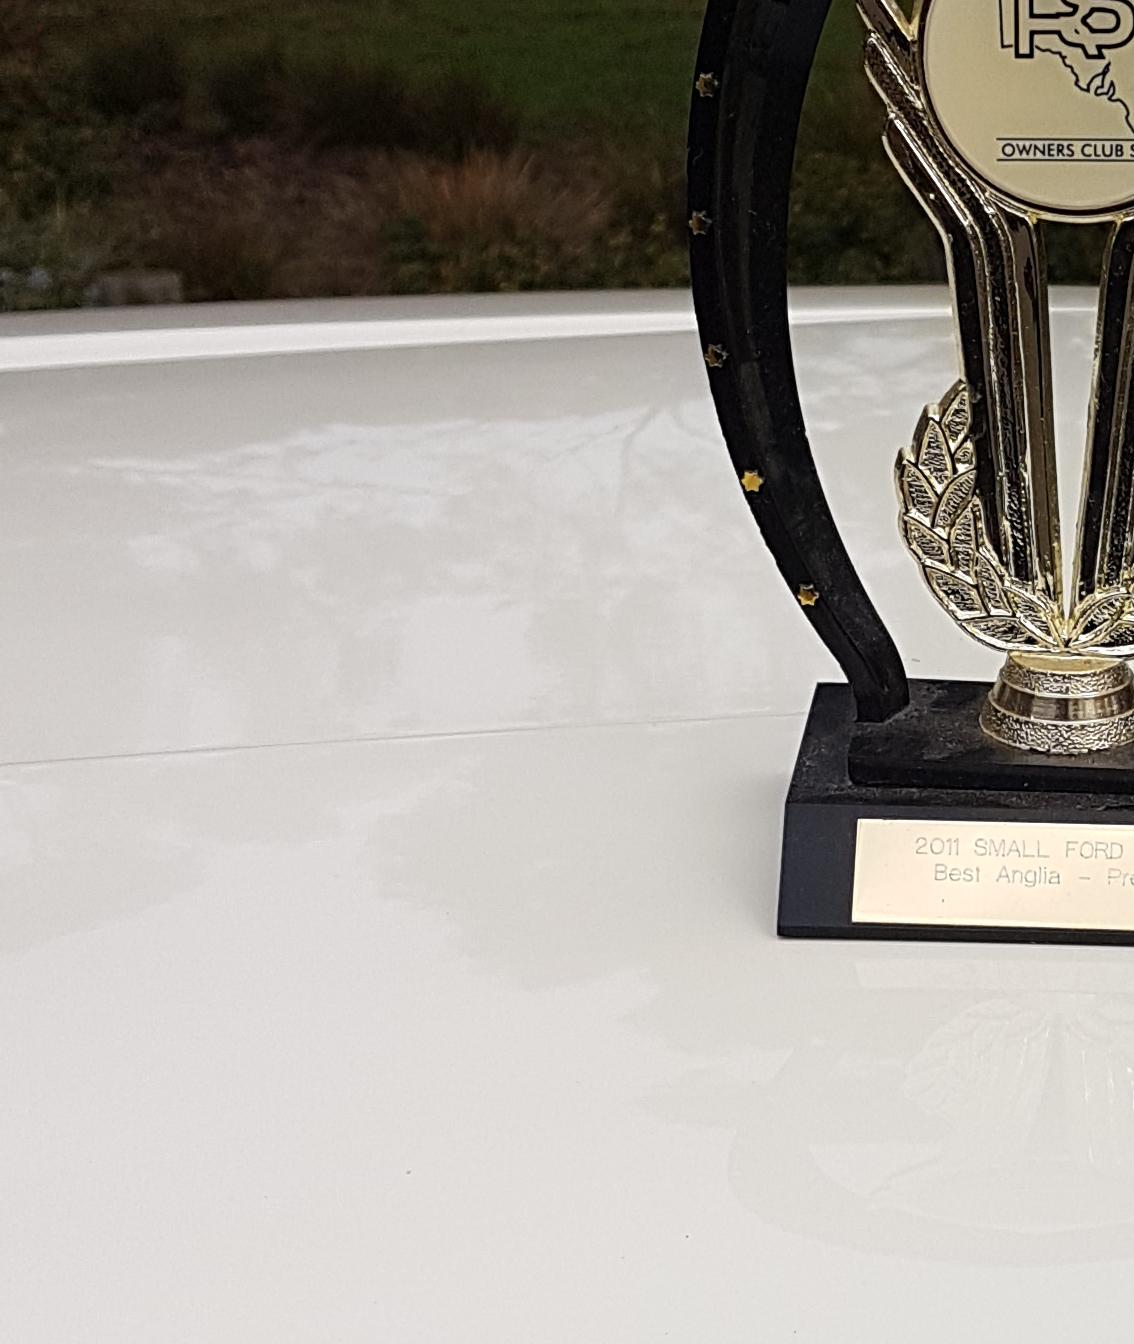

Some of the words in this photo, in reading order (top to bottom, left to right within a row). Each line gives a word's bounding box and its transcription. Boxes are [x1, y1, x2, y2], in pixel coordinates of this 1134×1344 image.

[1001, 142, 1075, 158] OWNERS
[1081, 142, 1124, 158] CLUB
[915, 836, 960, 856] 2011
[974, 837, 1050, 859] SMALL
[1065, 840, 1124, 861] FORD
[934, 863, 981, 883] Best
[995, 865, 1061, 888] Anglia
